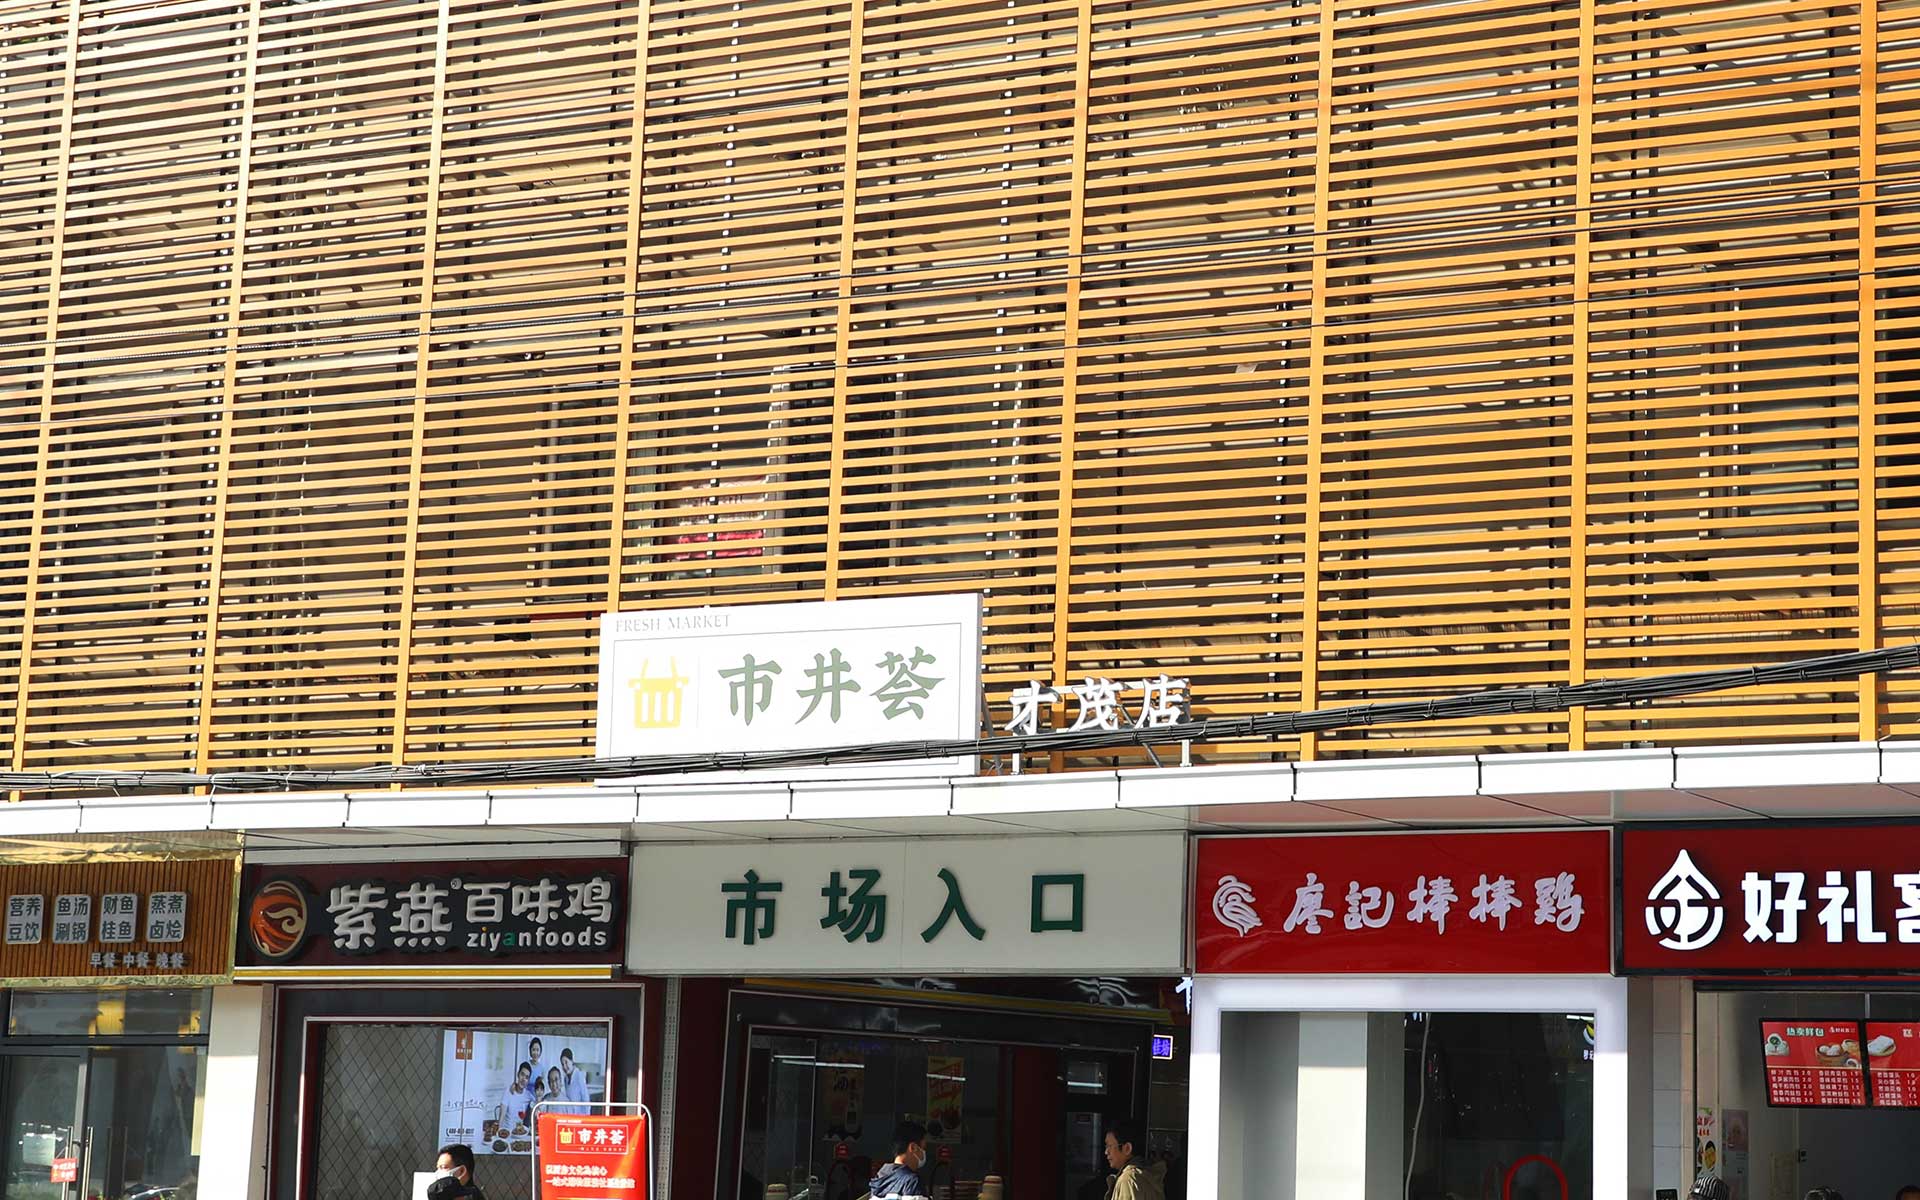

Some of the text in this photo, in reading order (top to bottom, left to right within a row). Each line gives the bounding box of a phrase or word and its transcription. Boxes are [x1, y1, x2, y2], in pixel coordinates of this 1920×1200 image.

[616, 614, 731, 633] FRESH MARKET
[718, 646, 945, 726] 市井荟
[1004, 673, 1188, 736] 才茂店
[9, 897, 41, 917] 营养
[57, 897, 88, 916] 鱼汤
[103, 896, 134, 915] 财鱼
[151, 894, 183, 914] 蒸煮
[721, 868, 1085, 945] 市场入口
[7, 922, 40, 941] 豆饮
[55, 922, 87, 941] 涮锅
[101, 921, 132, 940] 桂鱼
[466, 926, 607, 951] ziyanfoods
[90, 952, 184, 969] 早餐 中餐 晚餐
